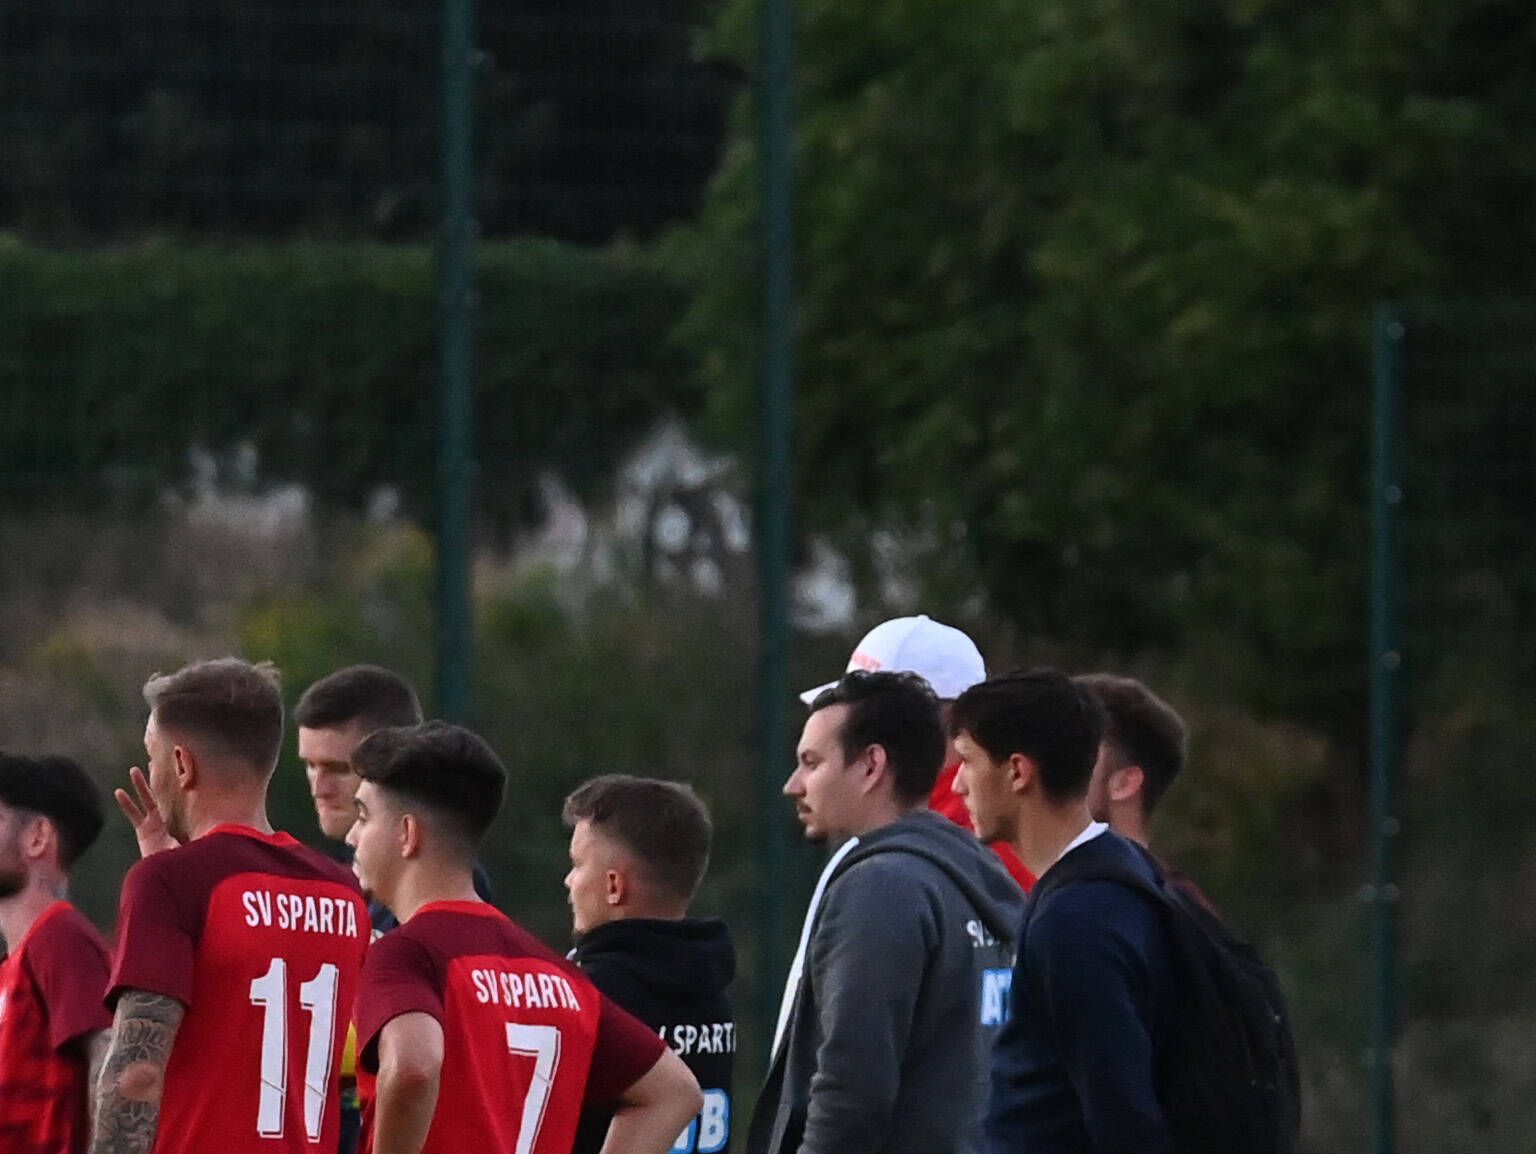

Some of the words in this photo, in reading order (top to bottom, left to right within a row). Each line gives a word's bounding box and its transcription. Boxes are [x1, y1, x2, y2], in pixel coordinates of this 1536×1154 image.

[242, 890, 272, 927] SV
[277, 893, 358, 938] SPARTA
[471, 969, 499, 1004] SV
[499, 972, 581, 1011] SPARTA
[249, 957, 339, 1143] 11
